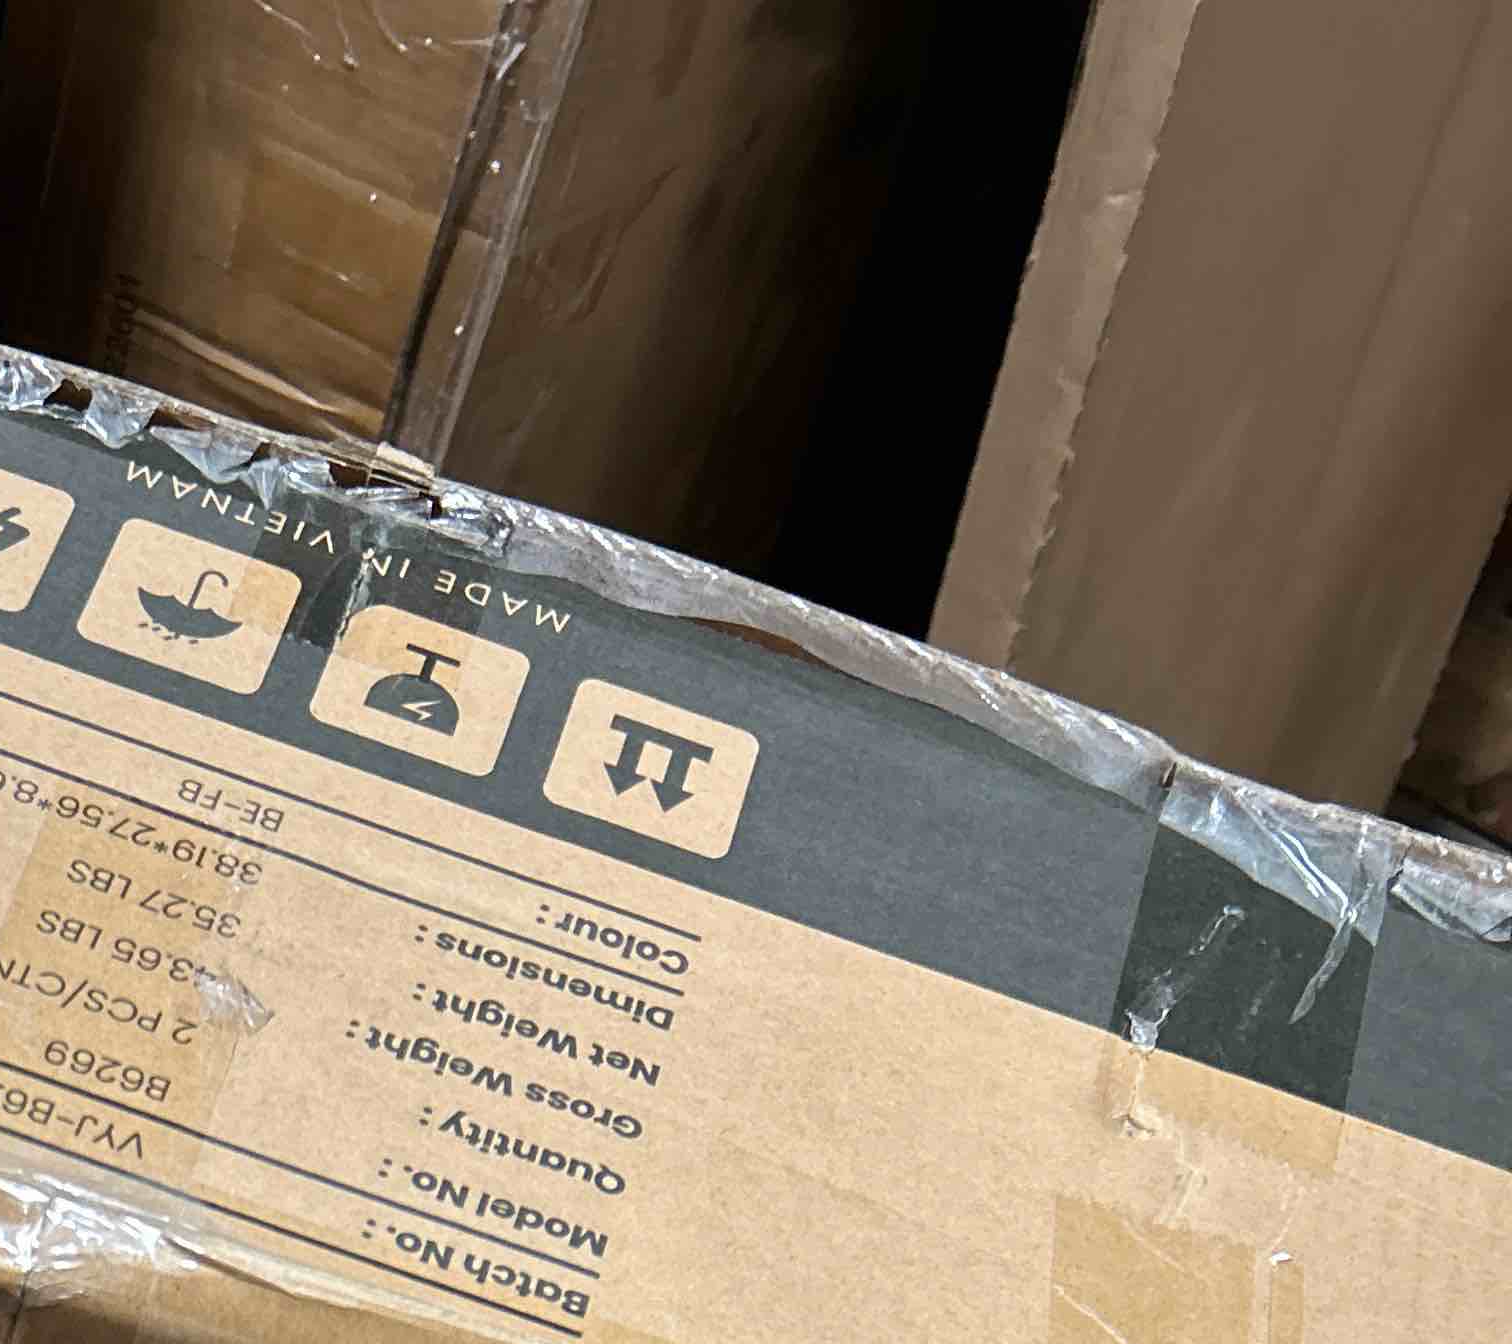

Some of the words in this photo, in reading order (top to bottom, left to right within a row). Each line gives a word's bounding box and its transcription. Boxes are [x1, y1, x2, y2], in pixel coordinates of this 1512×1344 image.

[126, 460, 336, 555] VIETNAM
[370, 553, 412, 579] IN
[433, 568, 571, 634] MADE
[178, 778, 285, 833] BE-FB
[66, 859, 132, 899] LBS
[35, 909, 102, 950] LBS
[140, 889, 241, 938] 35.27
[172, 1021, 198, 1045] 2
[44, 1040, 172, 1102] B6269
[589, 1041, 662, 1087] Net
[524, 1081, 644, 1140] Gross
[478, 1192, 608, 1258] Model
[463, 1252, 590, 1318] Batch
